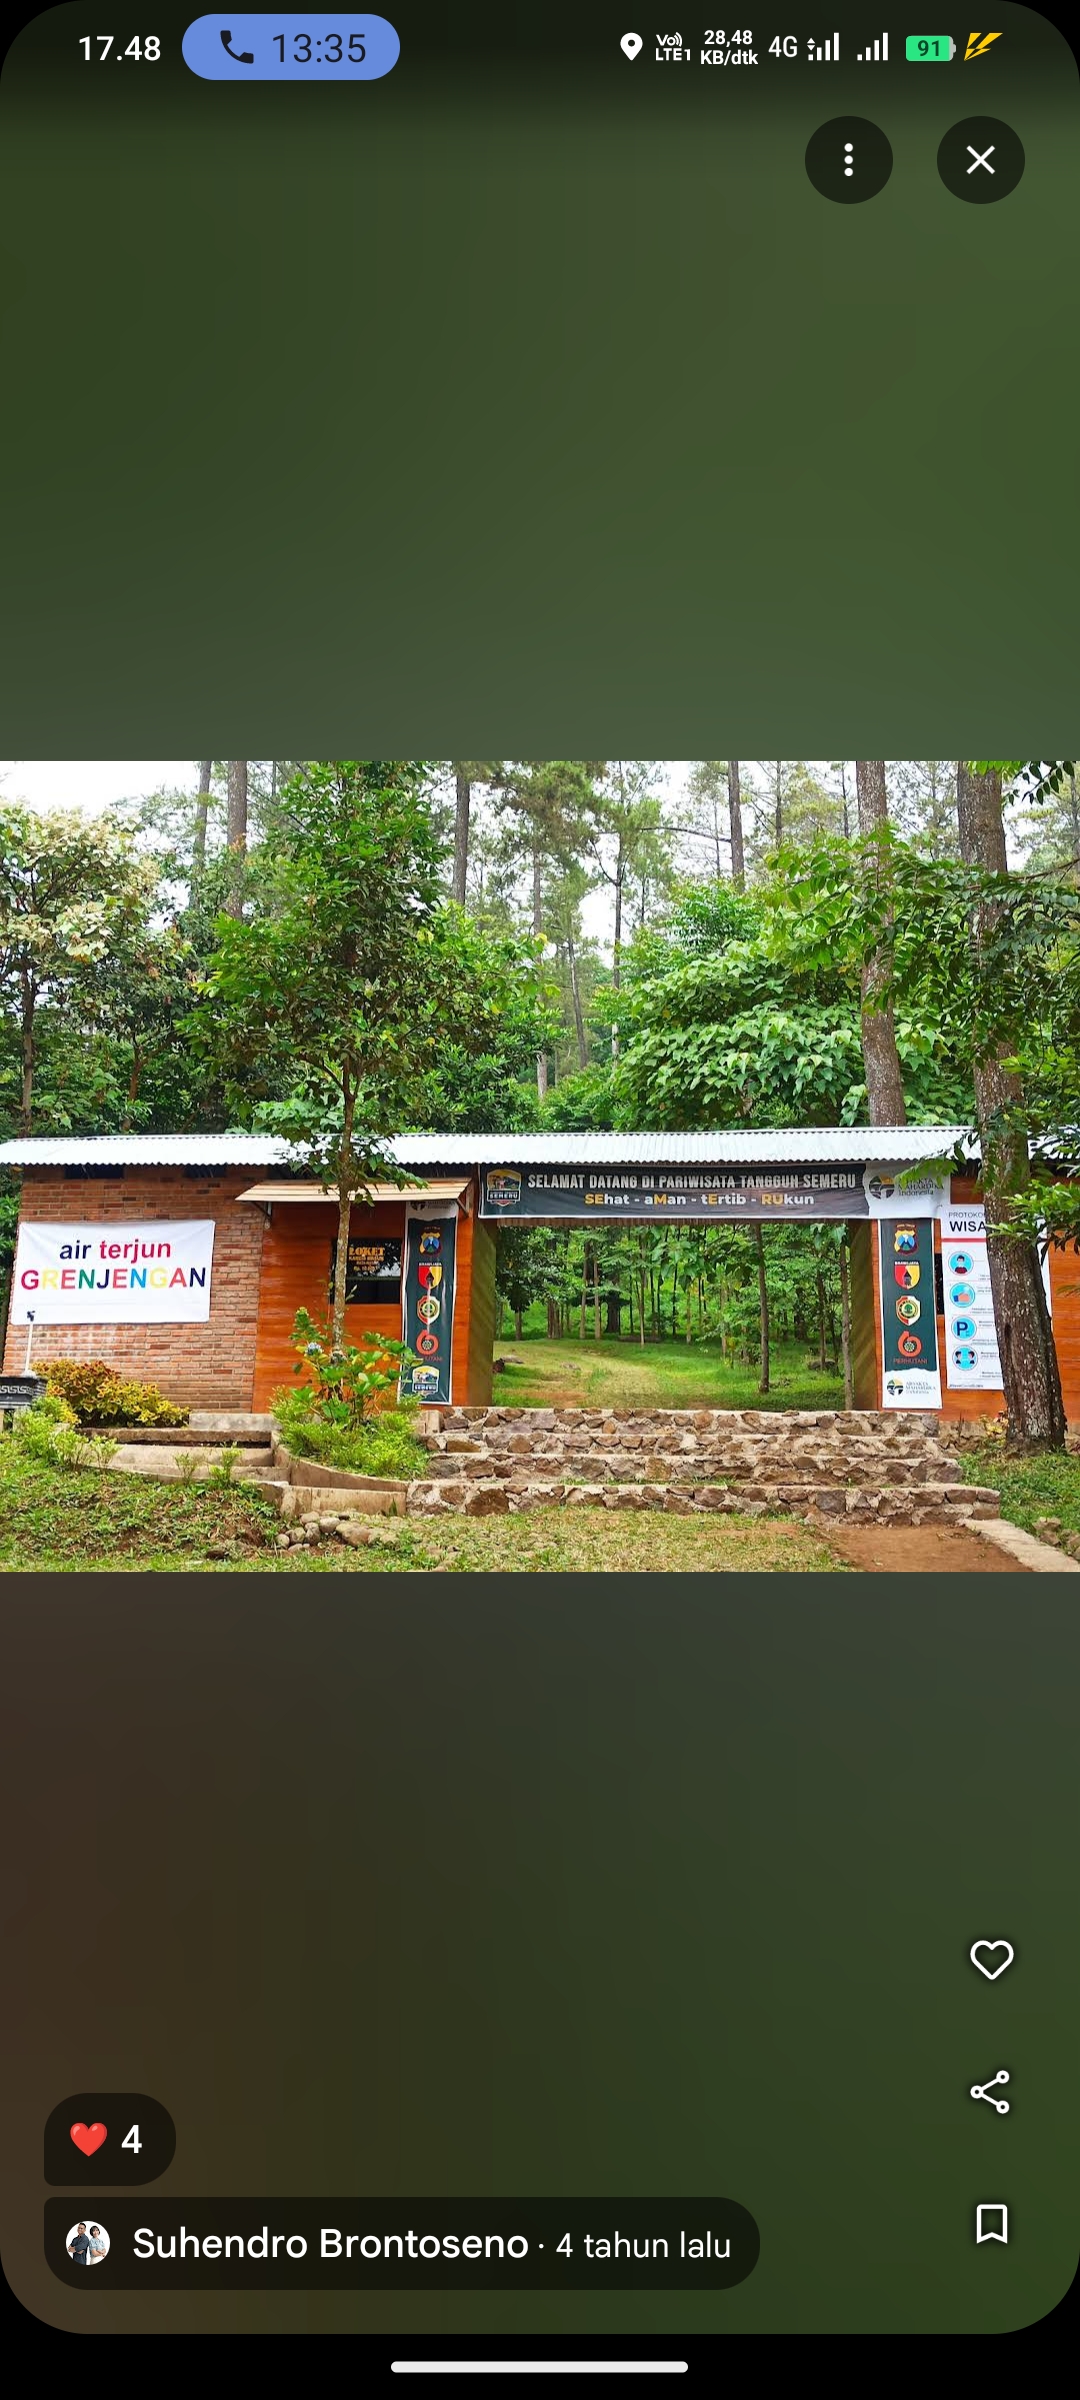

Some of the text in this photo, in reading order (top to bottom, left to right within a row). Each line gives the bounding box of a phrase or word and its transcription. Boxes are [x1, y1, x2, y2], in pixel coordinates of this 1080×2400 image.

[528, 1173, 856, 1189] SELAMAT DATANG DI PARIWISATA TANGGUH SEMERU
[584, 1193, 630, 1205] SEhat
[644, 1194, 687, 1205] aMan
[701, 1193, 747, 1205] tErtib
[761, 1193, 814, 1205] RUkun
[949, 1220, 986, 1233] WISA
[59, 1239, 171, 1264] air terjun
[20, 1267, 206, 1290] GRENJENGAN
